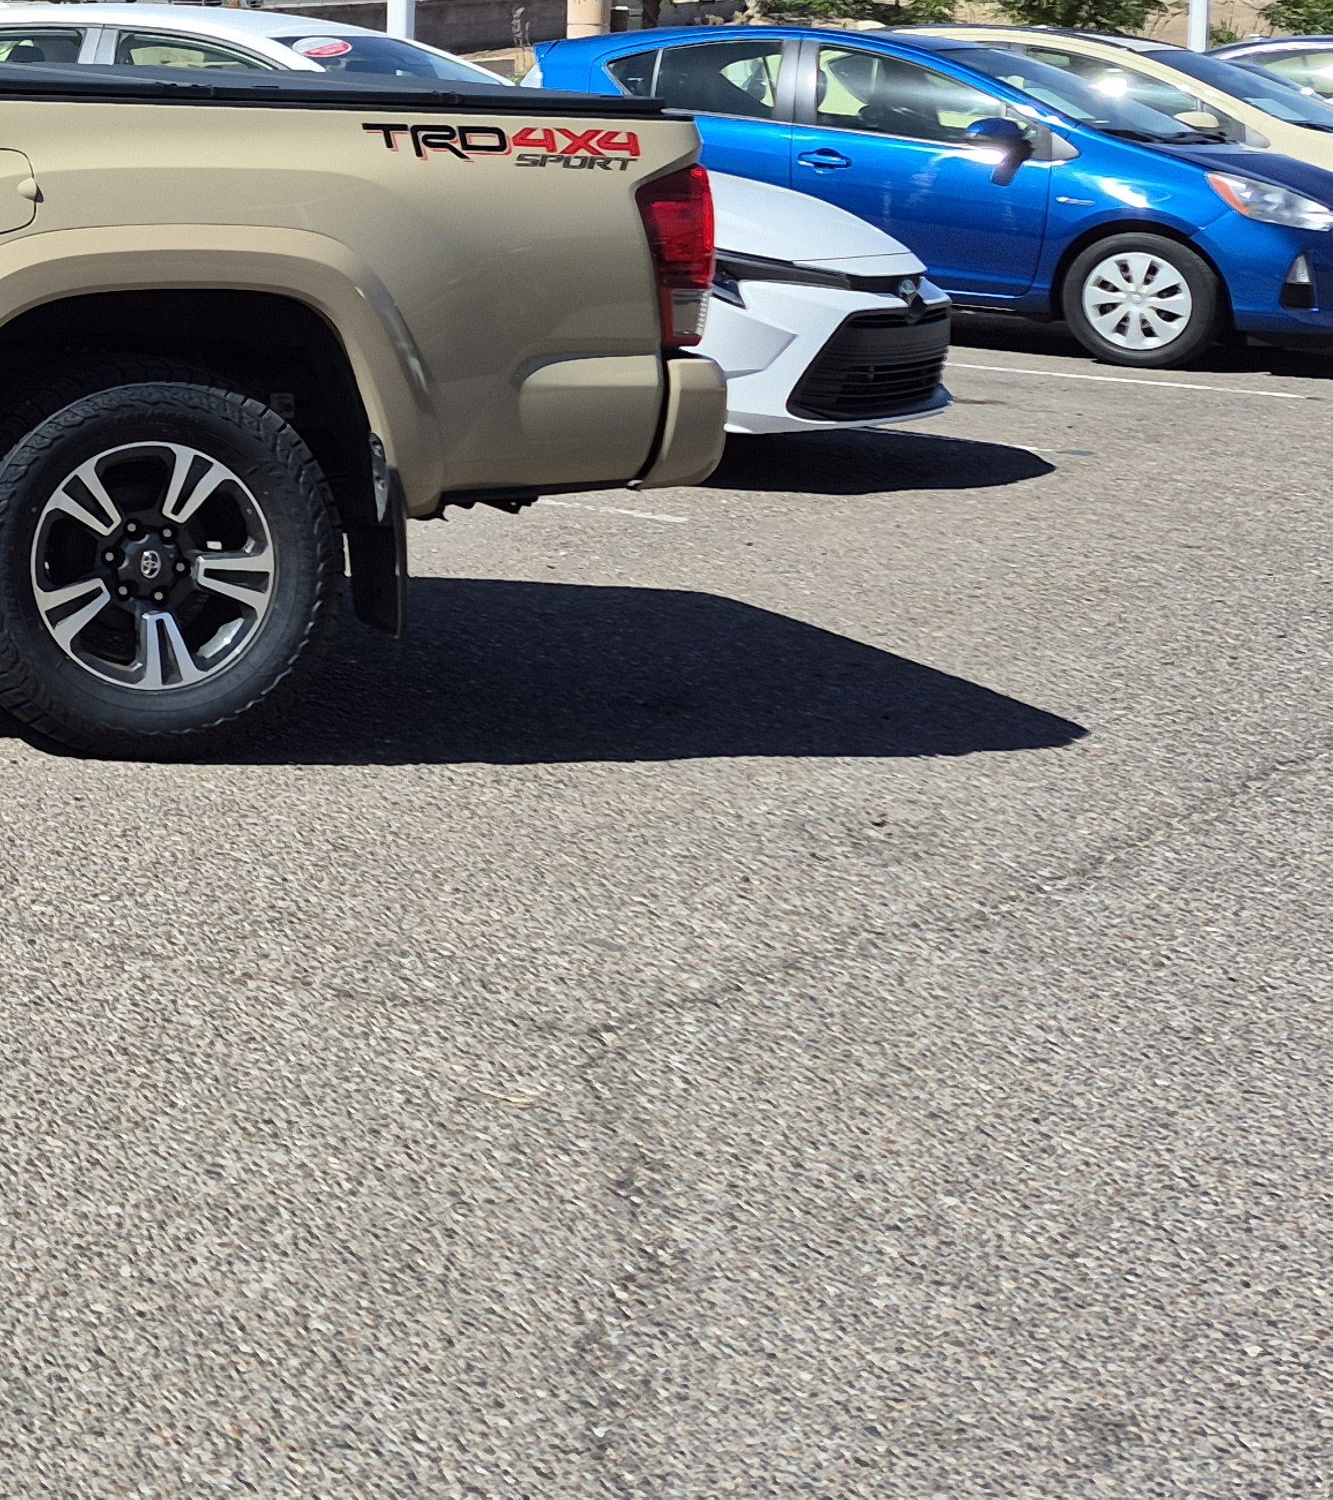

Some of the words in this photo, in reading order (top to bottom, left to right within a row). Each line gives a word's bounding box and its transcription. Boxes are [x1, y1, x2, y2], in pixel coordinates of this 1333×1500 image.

[362, 123, 513, 163] TRD
[512, 127, 641, 156] 4X4
[515, 153, 638, 171] SPORT
